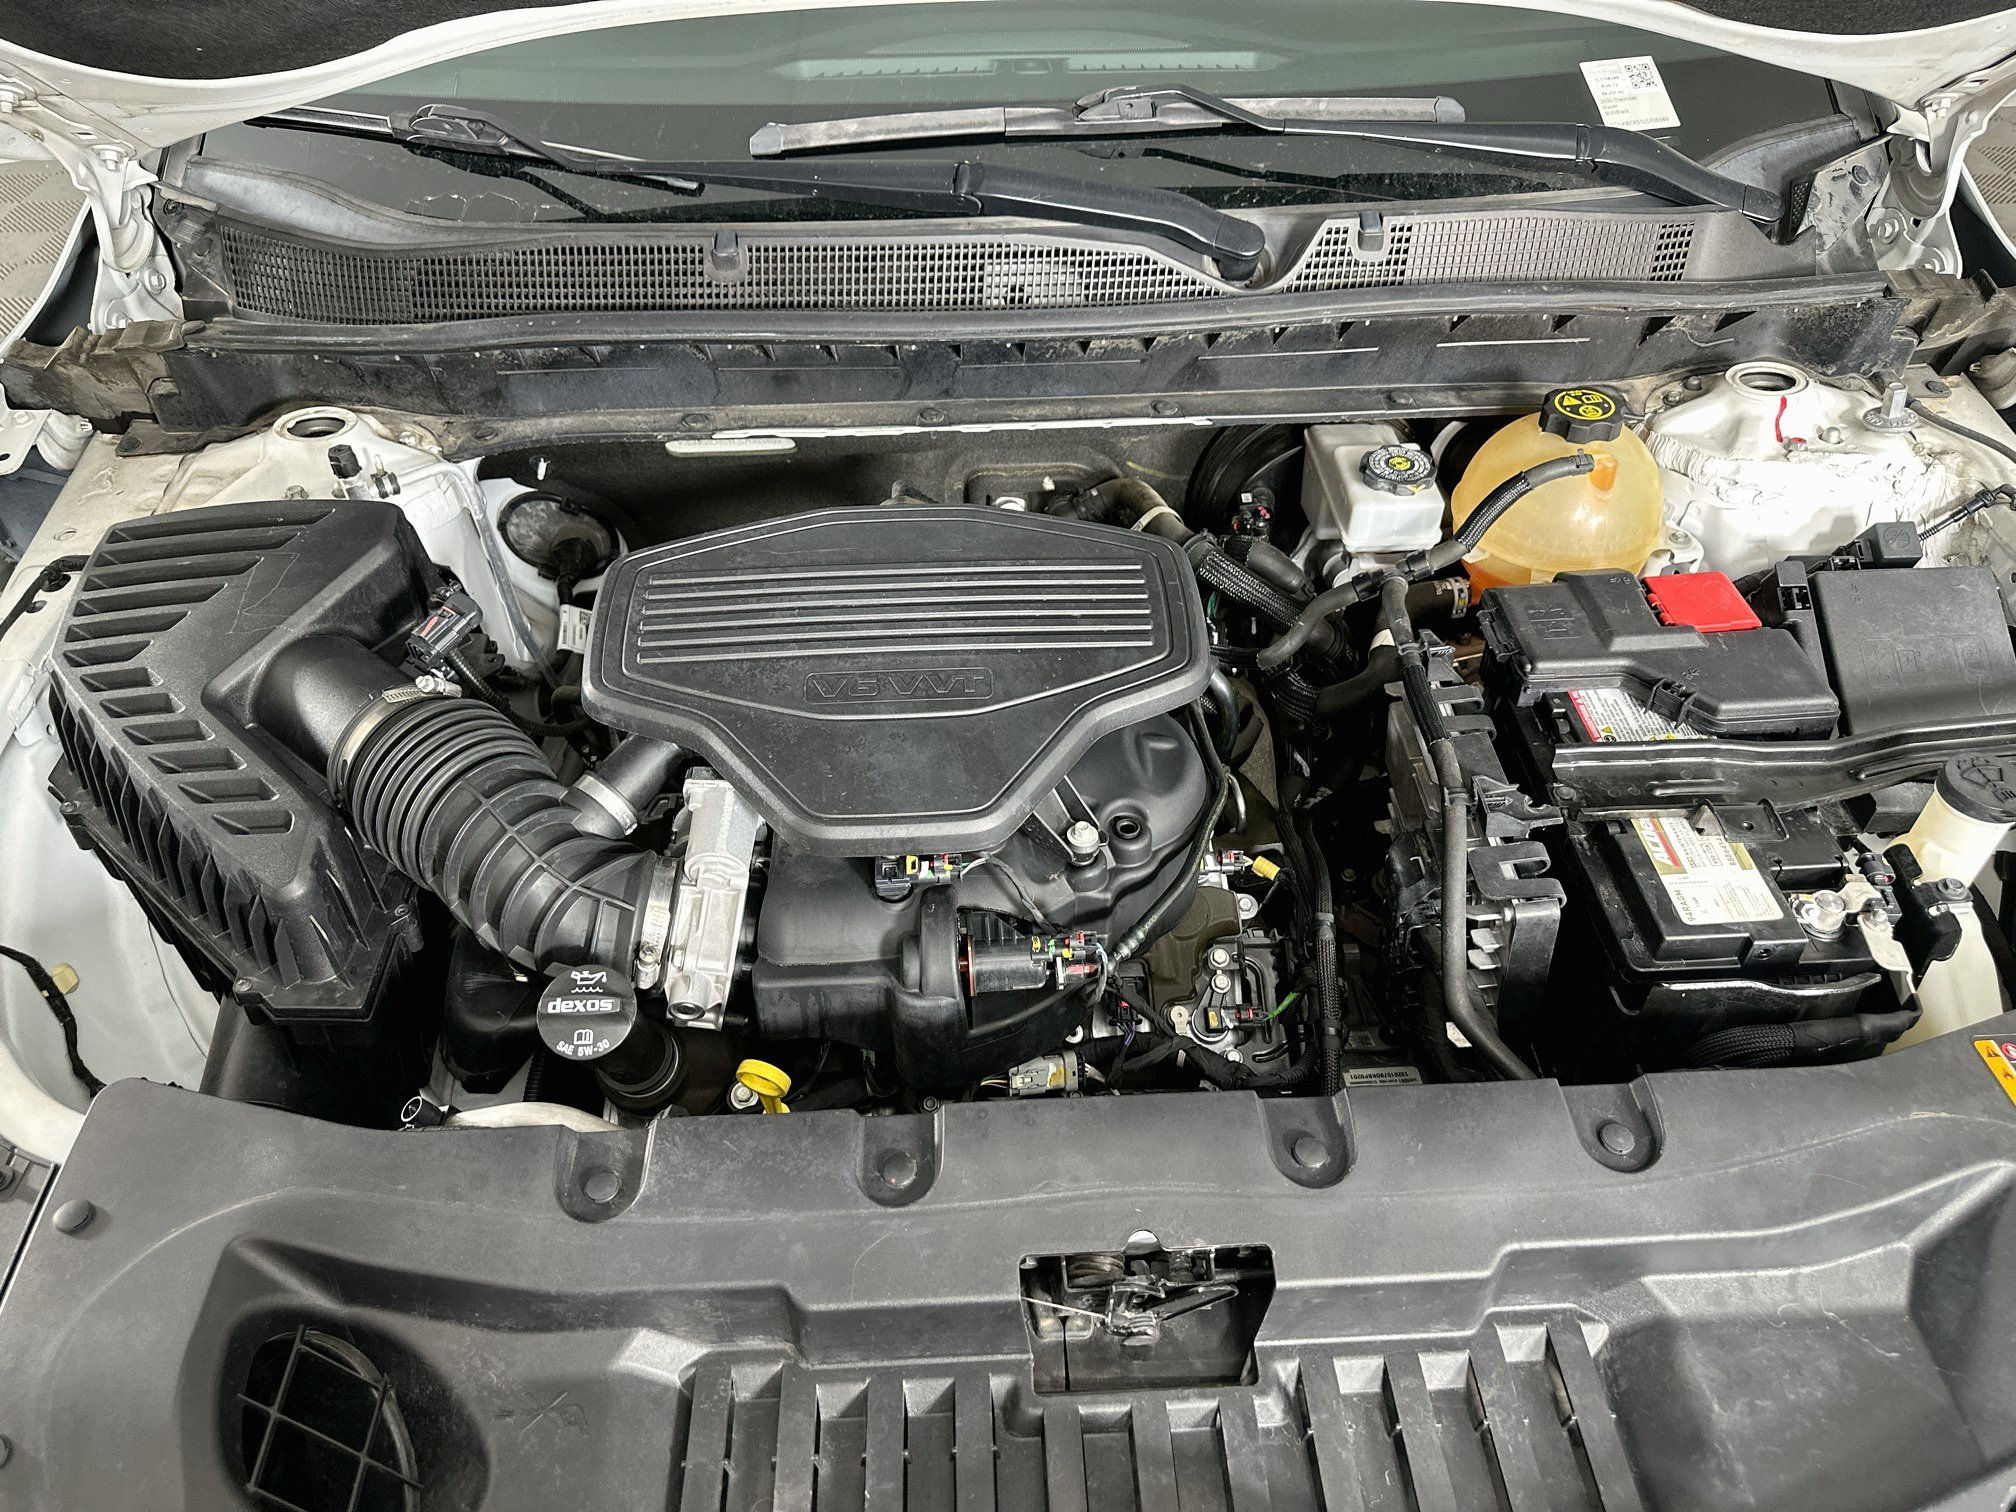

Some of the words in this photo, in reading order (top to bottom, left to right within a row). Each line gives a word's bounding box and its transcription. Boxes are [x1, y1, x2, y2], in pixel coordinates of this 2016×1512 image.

[812, 678, 878, 697] V6
[888, 675, 985, 695] VVT
[1639, 817, 1674, 866] ACDe
[1673, 889, 1696, 921] 94RAGM
[548, 997, 613, 1014] dexos
[556, 1041, 575, 1055] SAE
[577, 1039, 610, 1057] 5W-30
